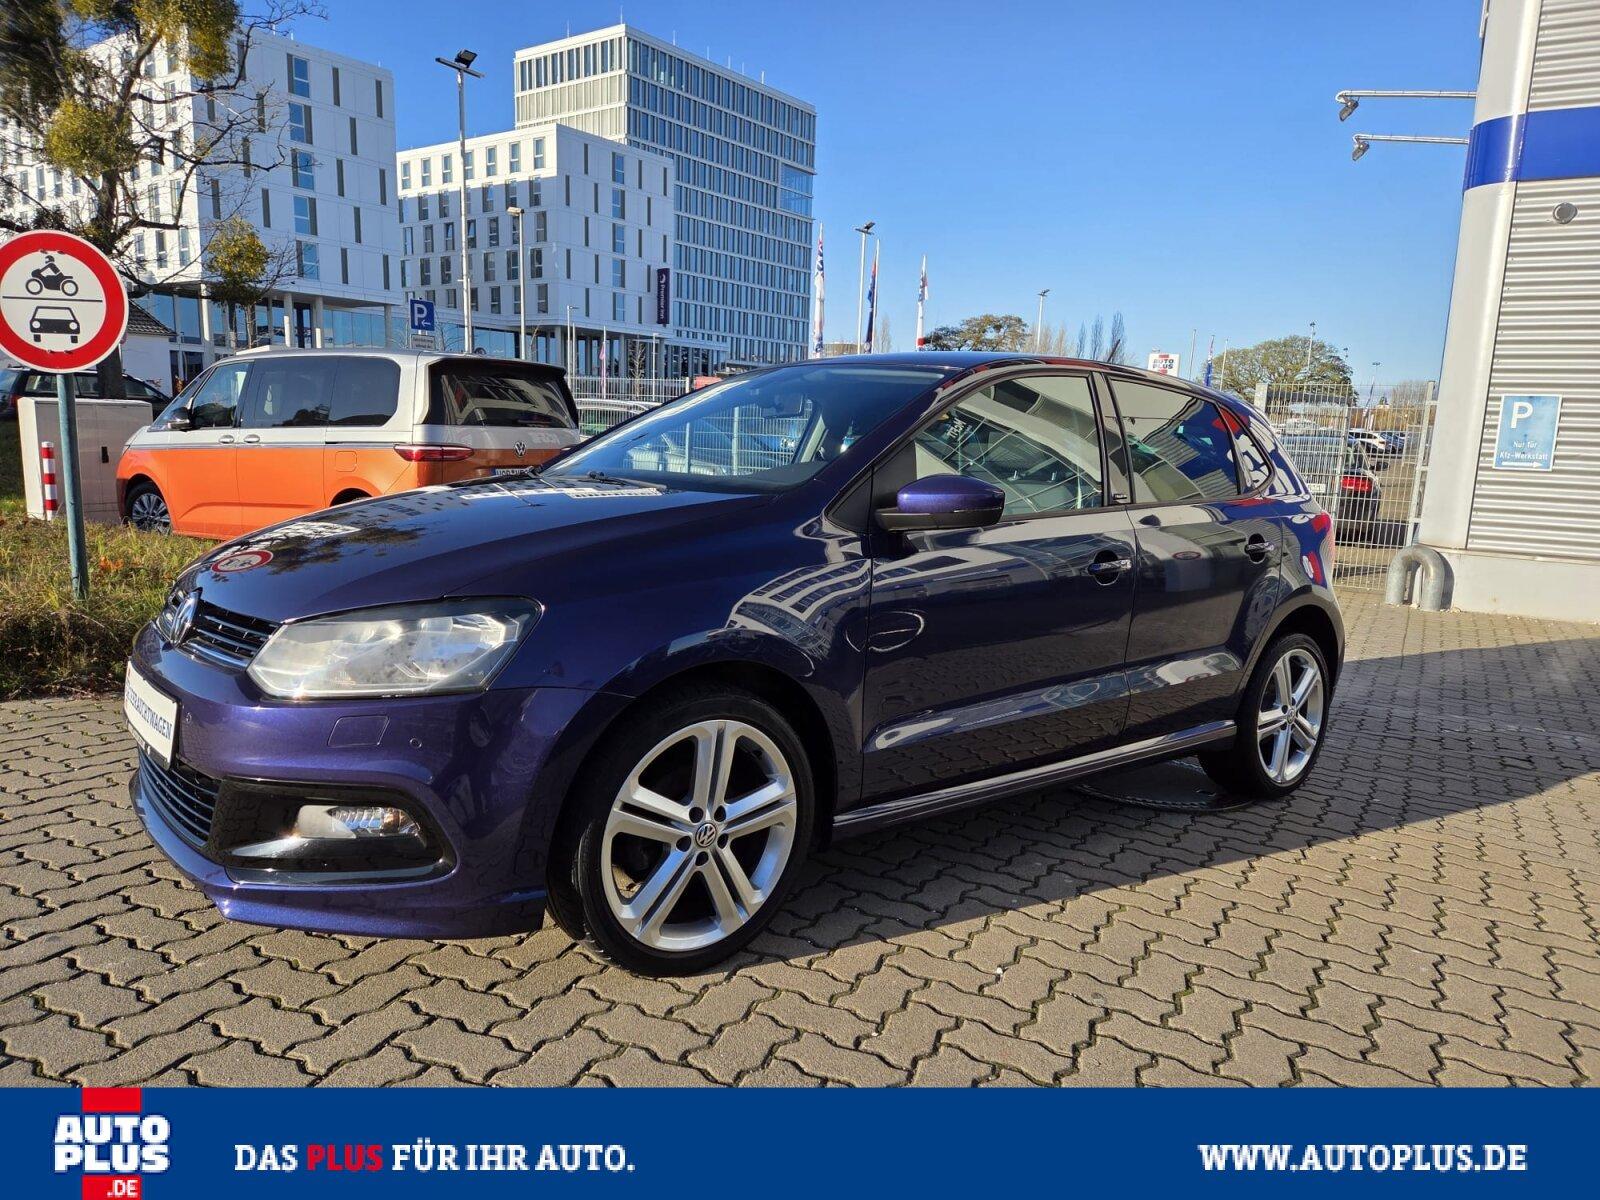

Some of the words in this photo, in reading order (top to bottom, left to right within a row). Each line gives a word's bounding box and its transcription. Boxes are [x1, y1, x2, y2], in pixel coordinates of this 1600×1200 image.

[414, 303, 428, 326] P
[1511, 401, 1533, 428] P
[1513, 440, 1525, 448] Nur
[1527, 440, 1537, 448] für
[1499, 451, 1548, 460] Kfz-Werkstatt
